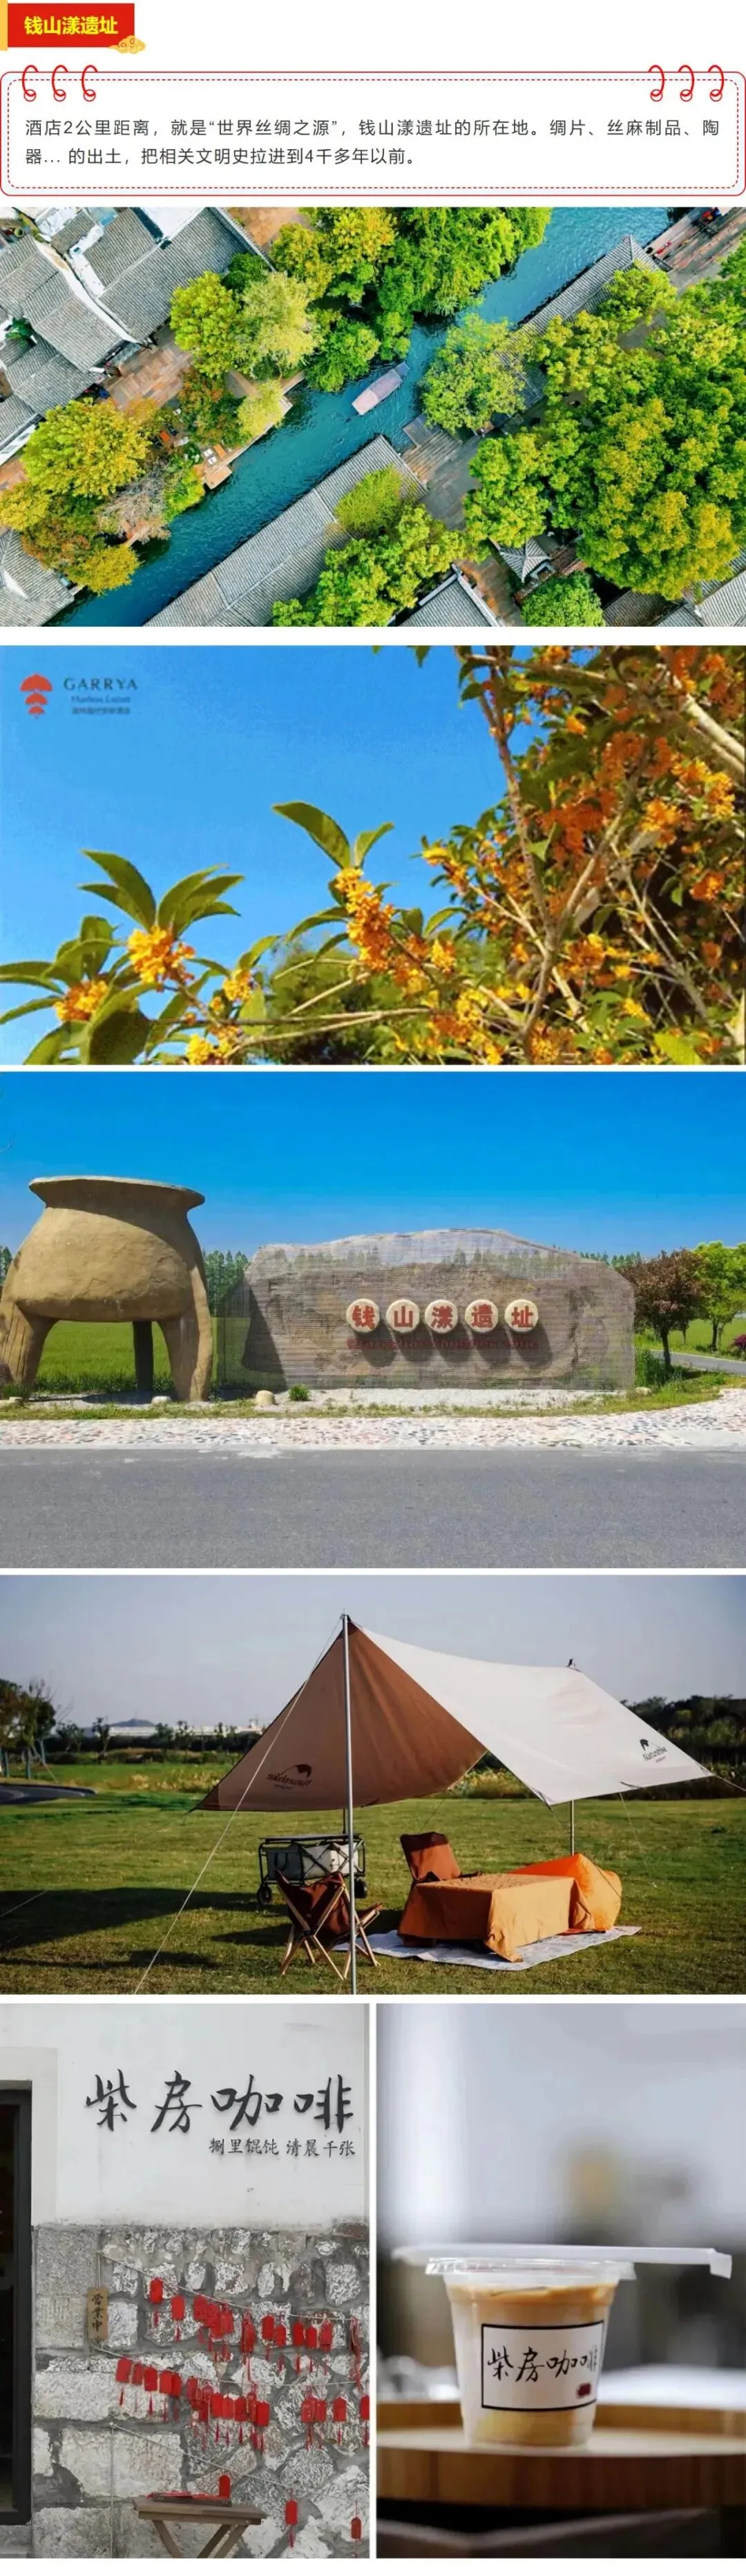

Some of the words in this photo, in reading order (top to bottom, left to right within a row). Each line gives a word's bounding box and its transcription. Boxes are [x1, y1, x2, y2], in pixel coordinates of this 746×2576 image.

[352, 1304, 533, 1329] 钱山漾遗址
[85, 2069, 354, 2133] 柴房咖啡
